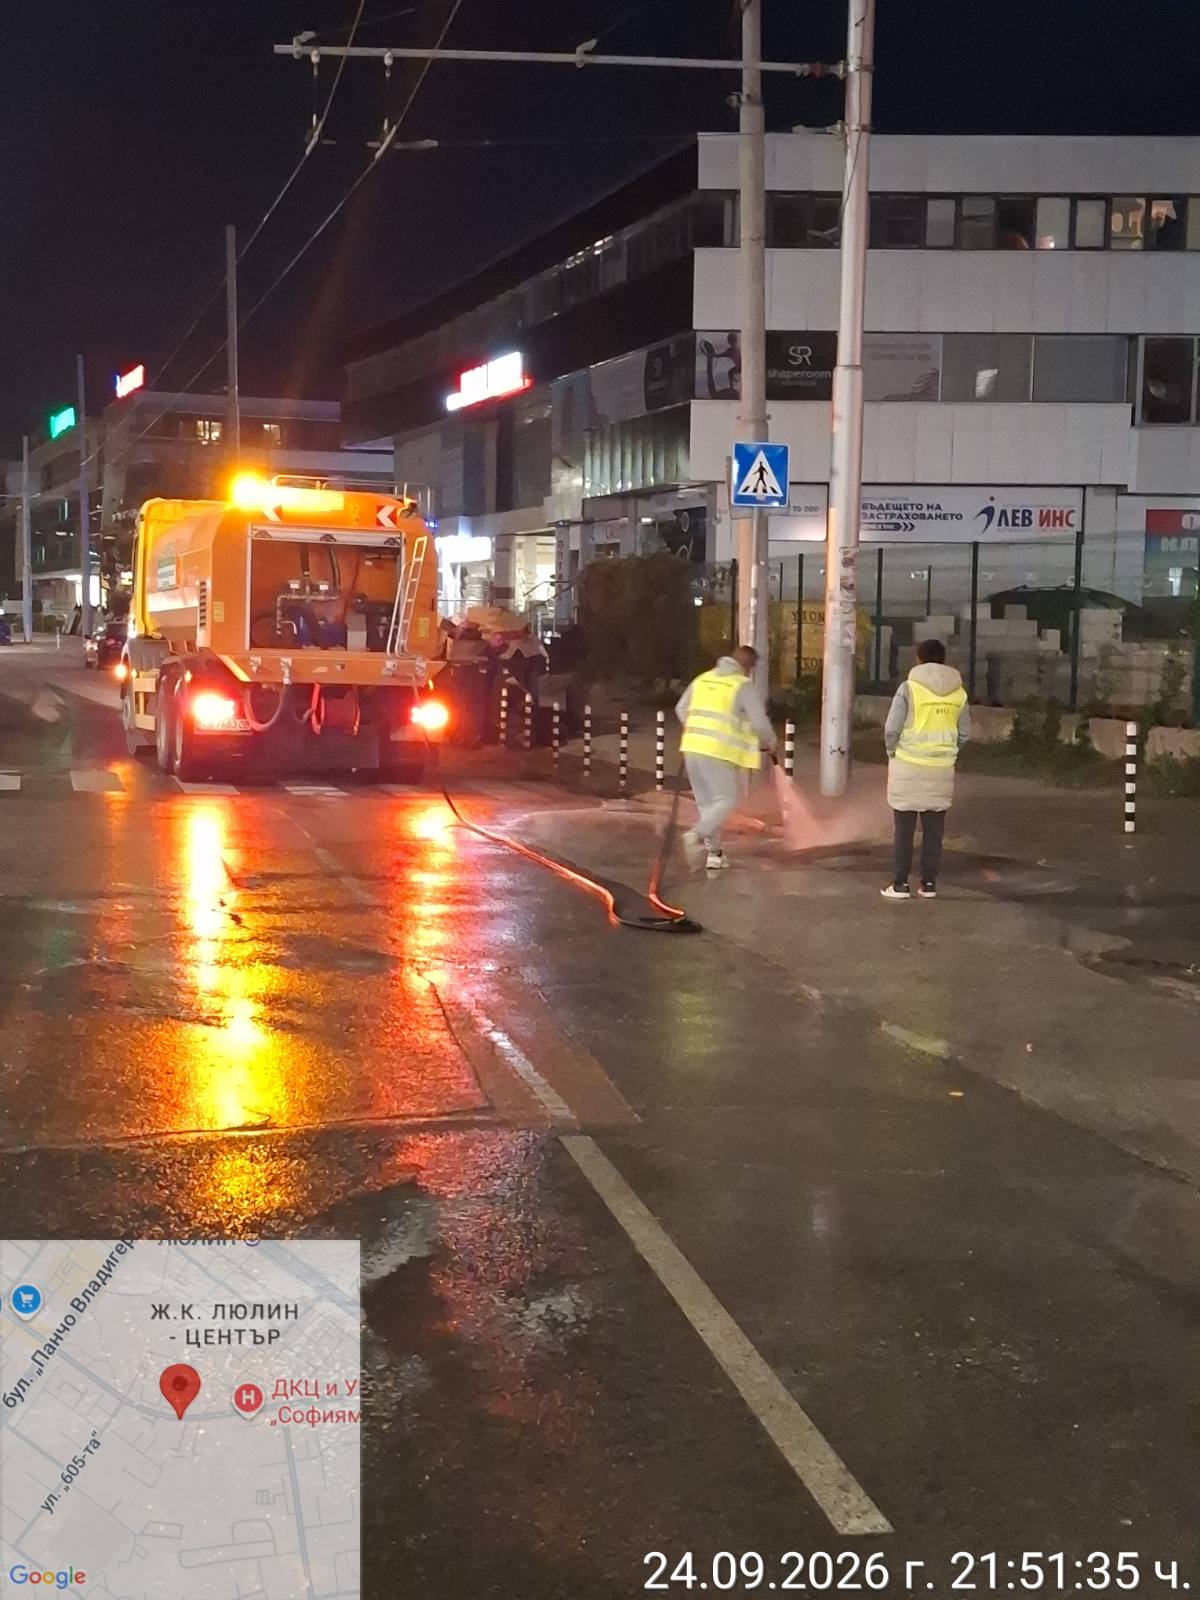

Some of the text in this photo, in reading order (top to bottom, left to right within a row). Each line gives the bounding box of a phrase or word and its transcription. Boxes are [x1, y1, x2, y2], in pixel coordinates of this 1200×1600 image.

[926, 502, 943, 512] НА
[997, 508, 1076, 527] ЛЕВ ИНС
